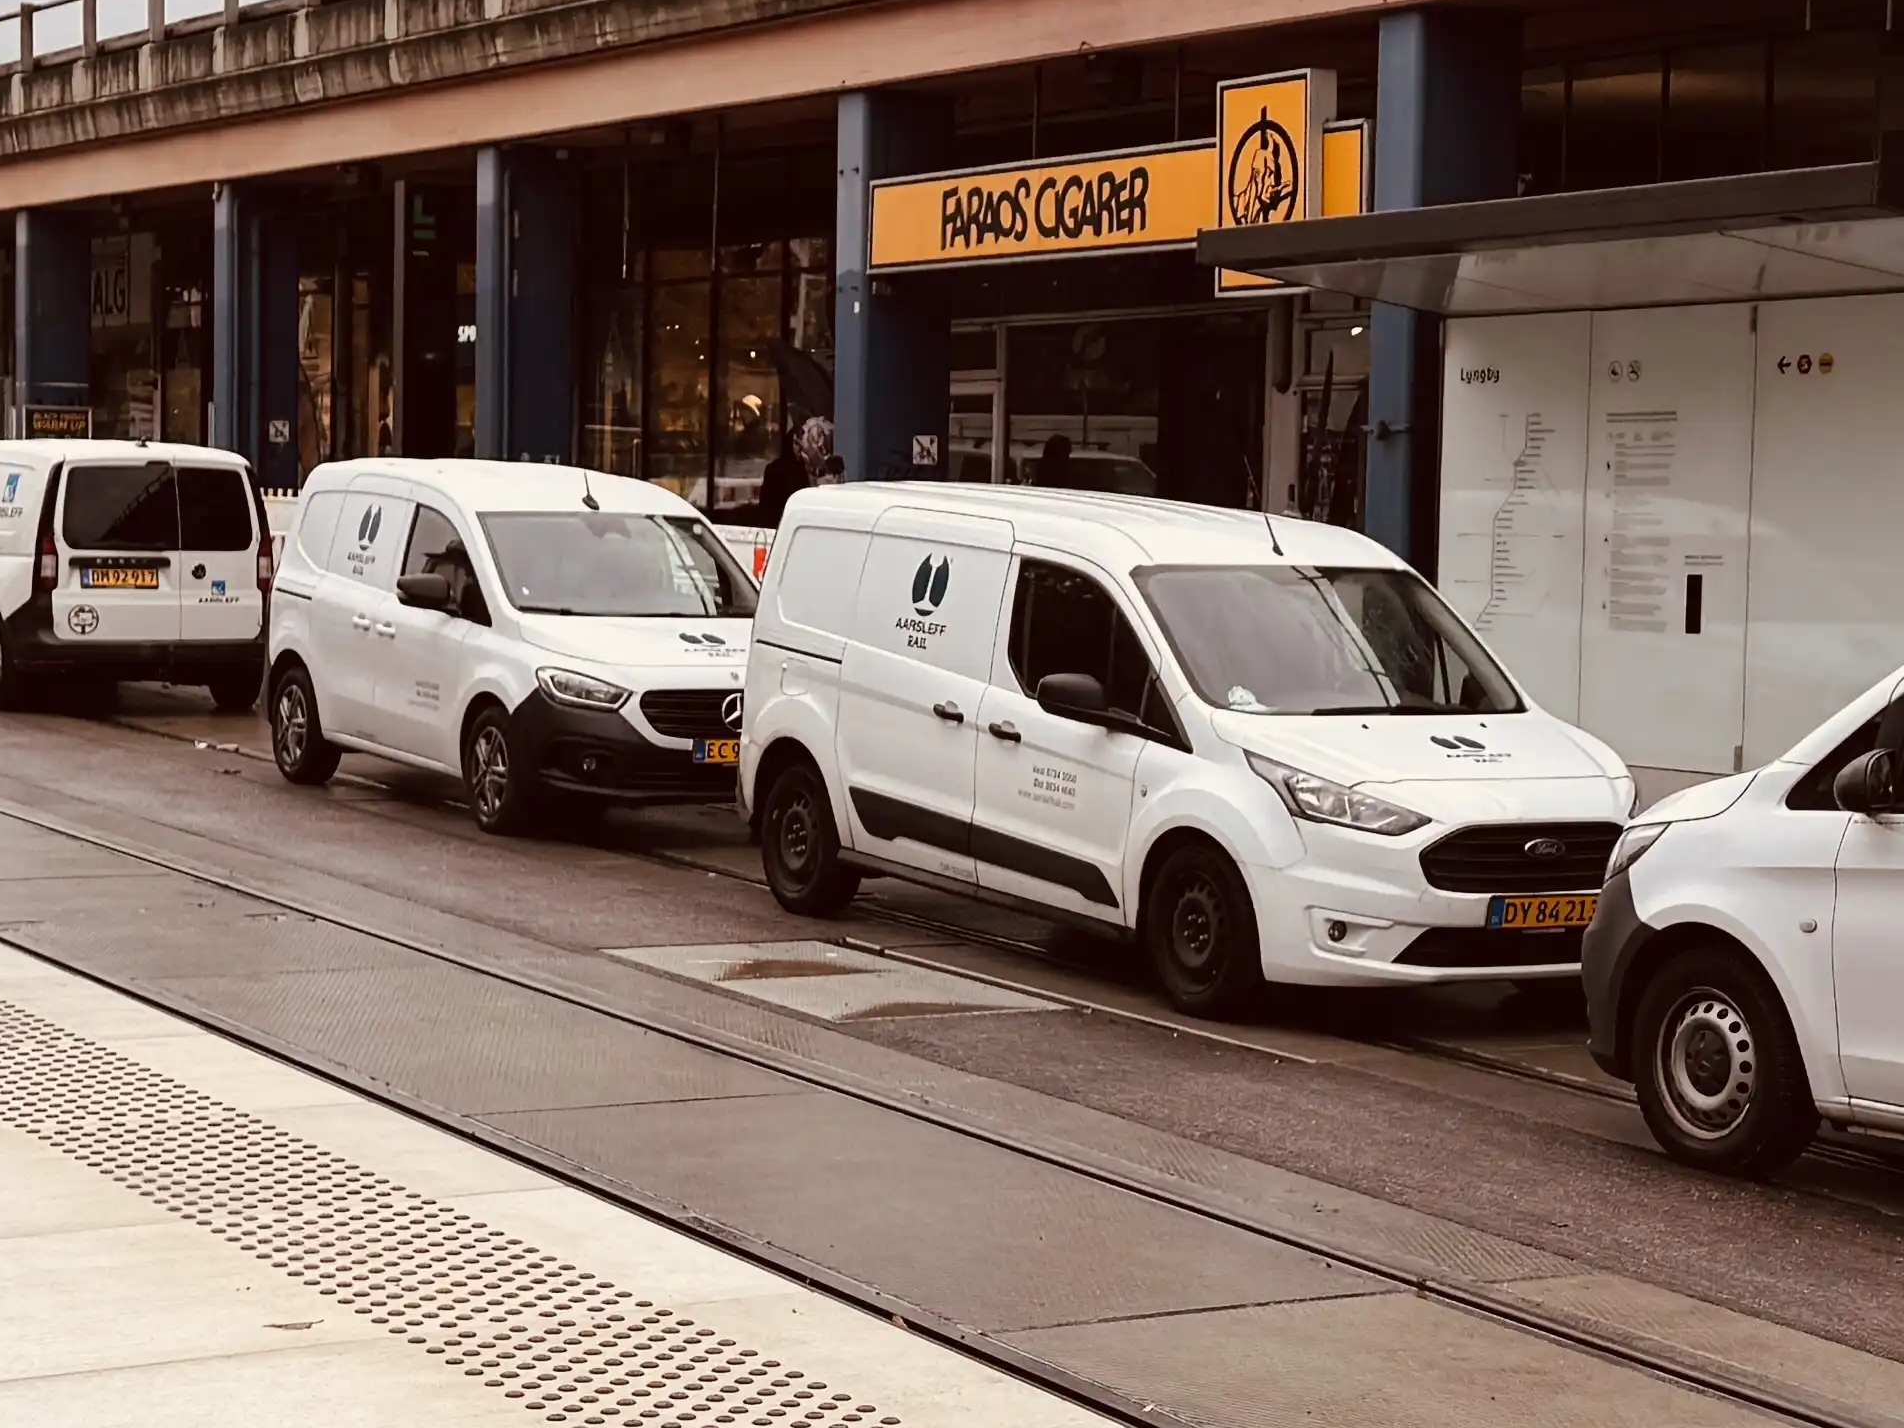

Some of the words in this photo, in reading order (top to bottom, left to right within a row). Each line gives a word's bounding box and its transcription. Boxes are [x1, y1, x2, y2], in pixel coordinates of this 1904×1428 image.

[941, 177, 1031, 251] FARAOS
[1034, 166, 1149, 239] CIGARER
[1460, 367, 1500, 384] Lyngby
[895, 617, 947, 636] AARSLEFF
[707, 742, 729, 759] EC
[1504, 900, 1533, 925] DY
[1535, 900, 1560, 924] 84
